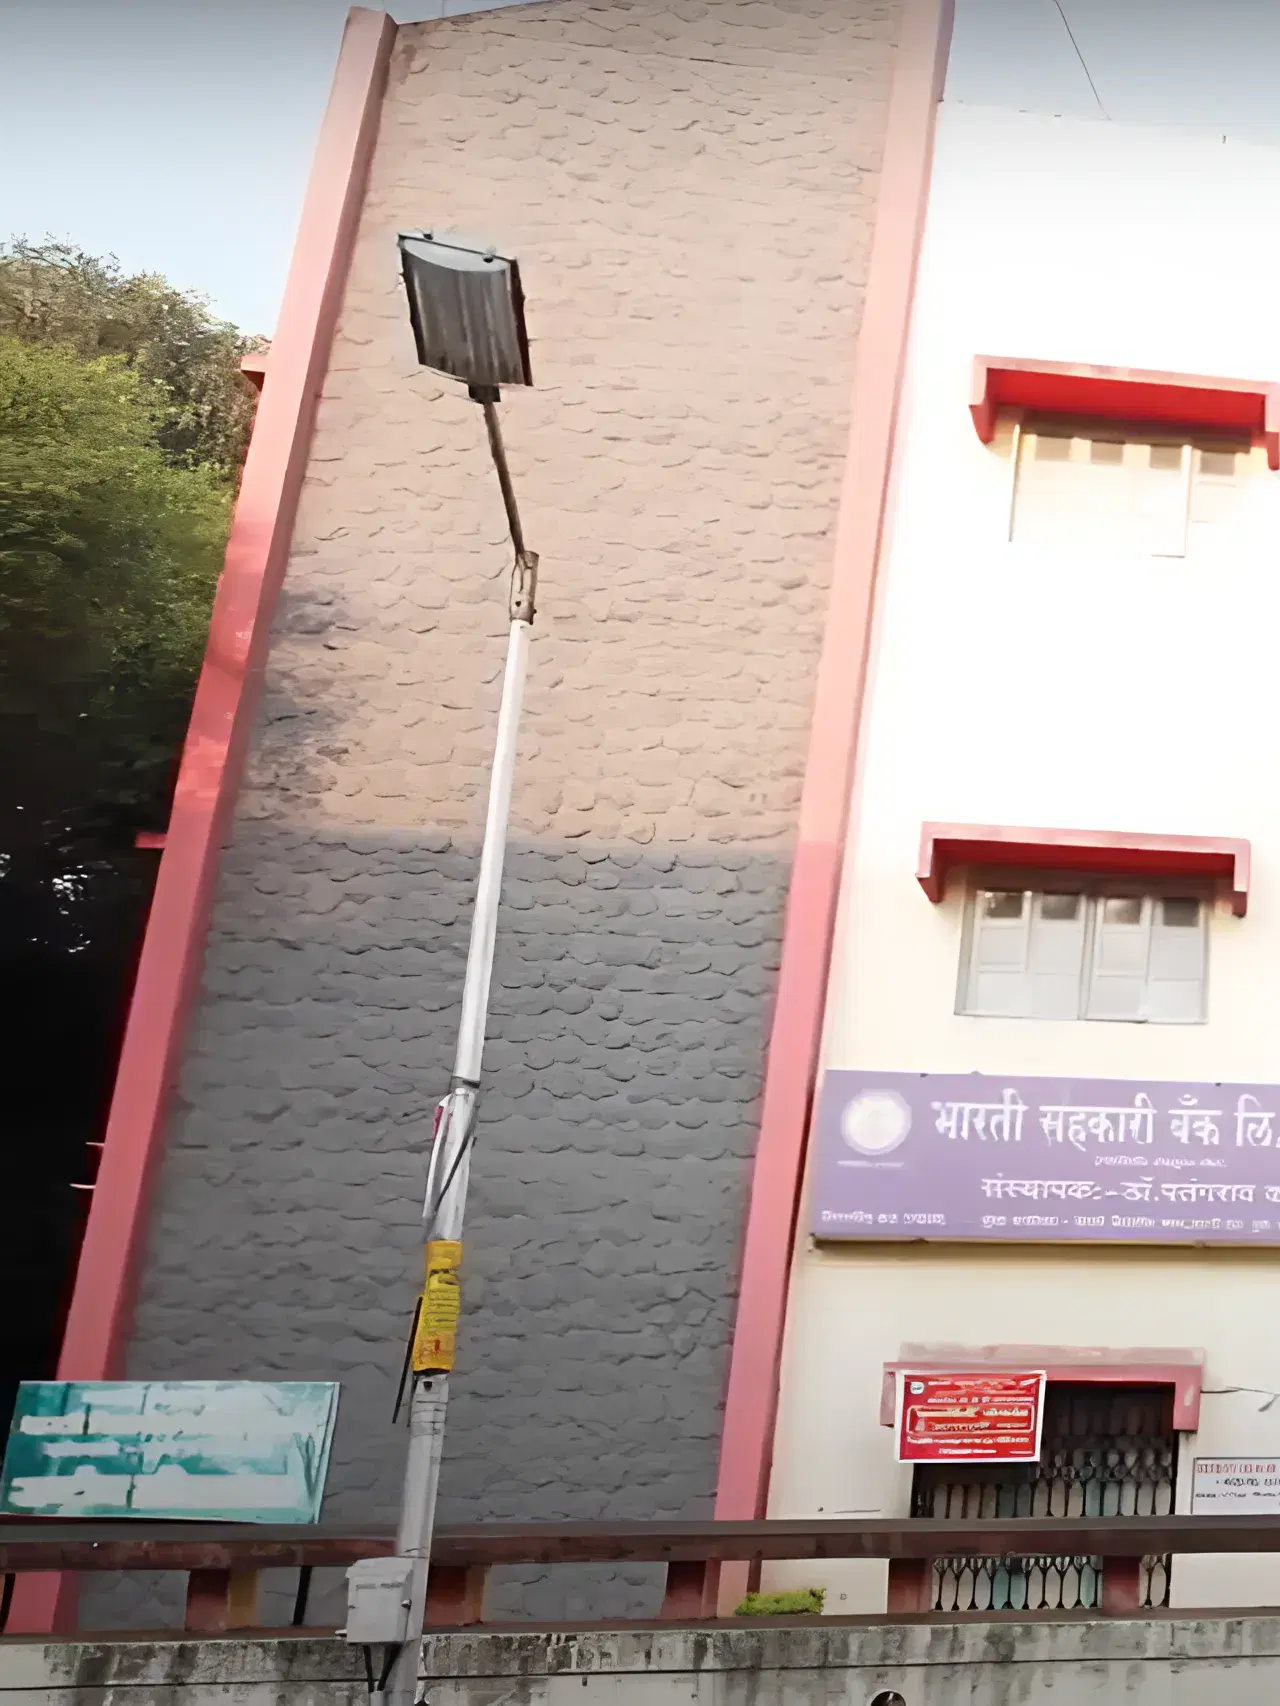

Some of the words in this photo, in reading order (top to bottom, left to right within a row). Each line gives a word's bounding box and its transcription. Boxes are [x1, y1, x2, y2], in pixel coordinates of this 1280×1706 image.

[930, 1087, 1029, 1141] भारती
[1038, 1091, 1157, 1152] सहकारी
[1168, 1093, 1223, 1146] बँक
